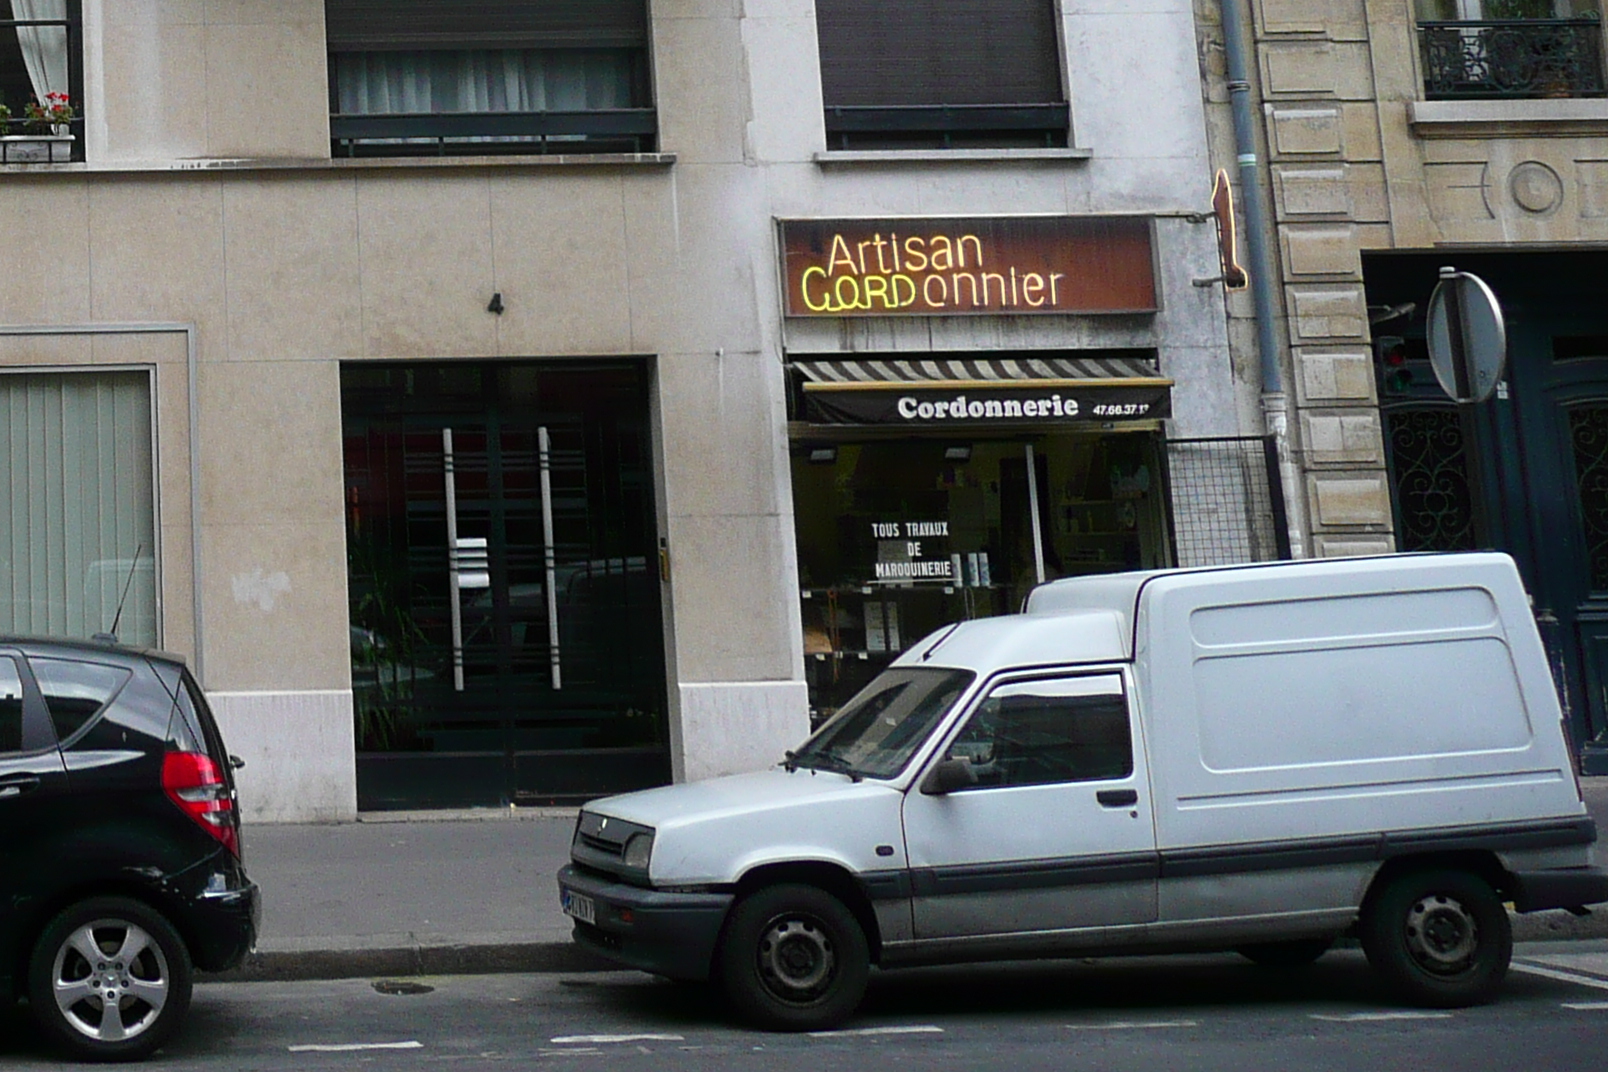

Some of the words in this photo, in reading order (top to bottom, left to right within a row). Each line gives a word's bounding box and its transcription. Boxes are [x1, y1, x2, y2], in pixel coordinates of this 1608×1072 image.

[827, 233, 983, 277] Artisan
[897, 394, 1080, 419] Cordonnerie
[872, 523, 900, 538] TOUS
[905, 522, 949, 537] TRAVAUX
[907, 542, 922, 556] DE
